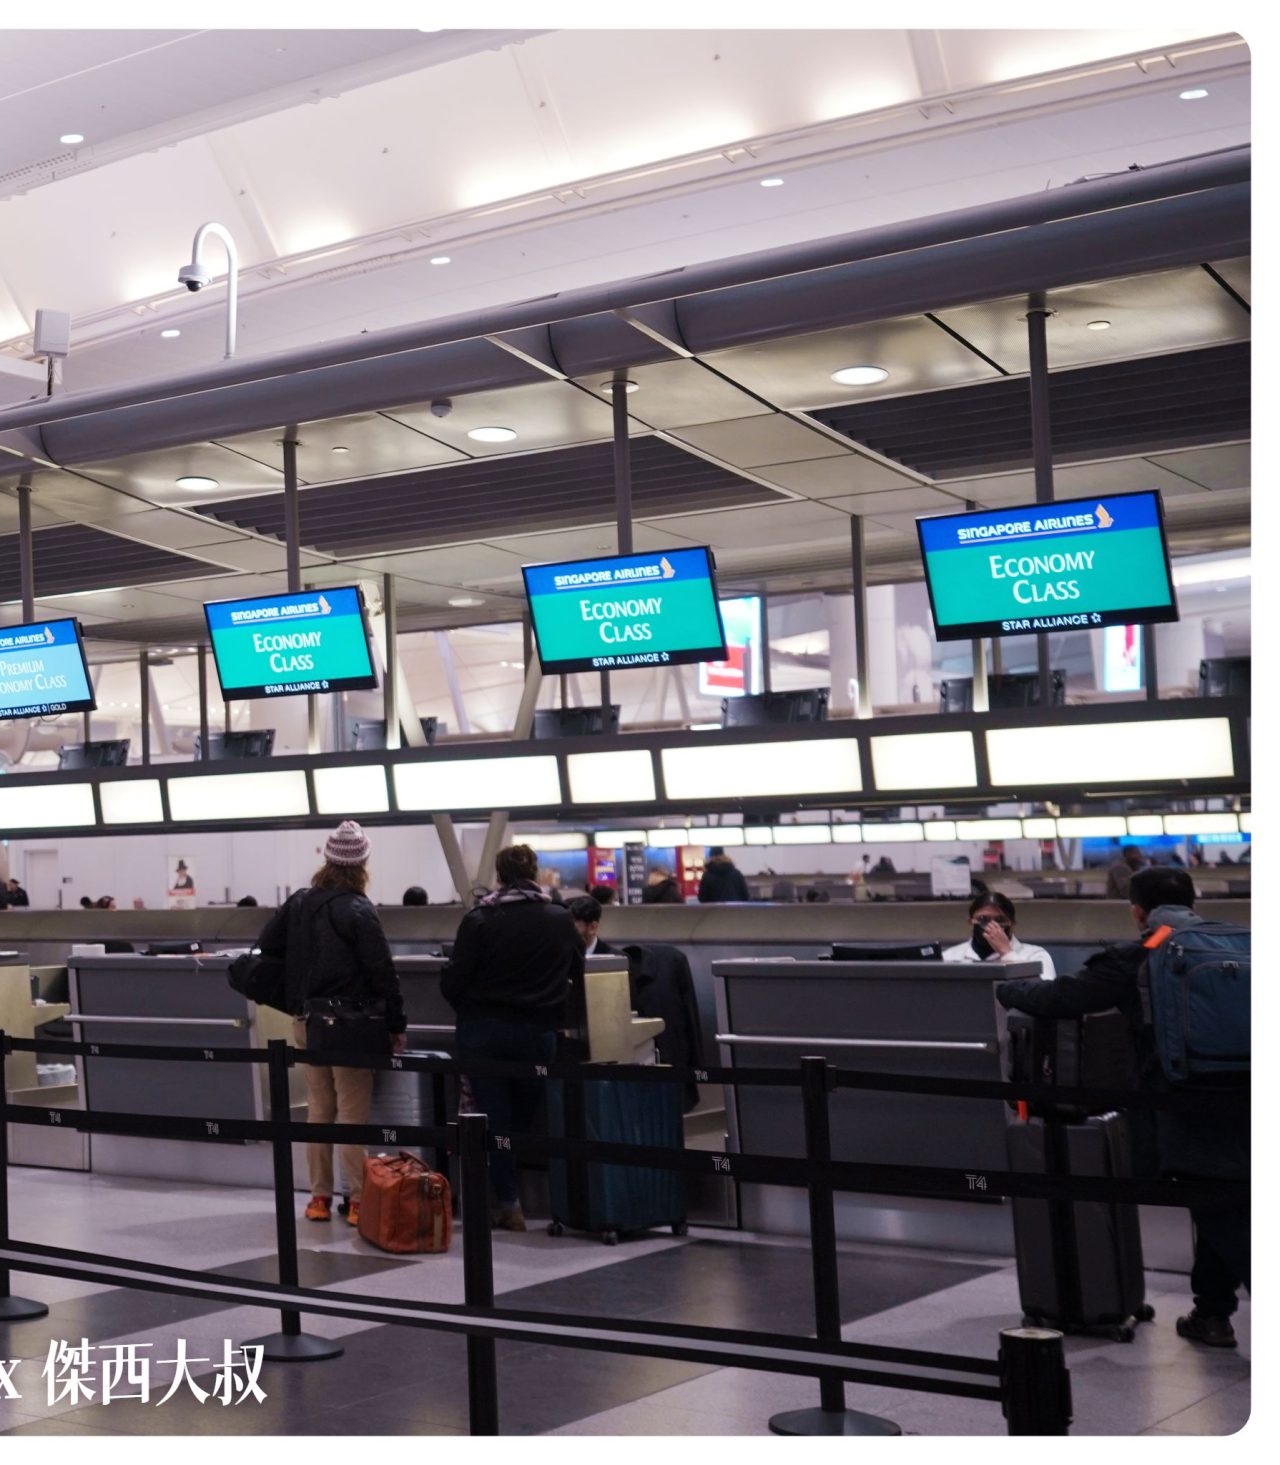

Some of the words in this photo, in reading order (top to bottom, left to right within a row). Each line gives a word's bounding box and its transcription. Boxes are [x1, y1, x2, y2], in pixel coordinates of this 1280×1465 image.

[957, 521, 1031, 540] SINGAPORE
[1034, 513, 1094, 531] AIRLINES
[988, 550, 1095, 579] ECONOMY
[554, 570, 612, 587] SINGAPORE
[614, 565, 660, 580] AIRLINES
[1012, 580, 1080, 604] CLASS
[231, 607, 279, 621] SINGAPORE
[280, 602, 319, 615] AIRLINES
[580, 598, 662, 621] ECONOMY
[1001, 619, 1031, 632] STAR
[1033, 614, 1089, 629] ALLIANCE
[14, 633, 45, 645] AIRLINES
[599, 621, 652, 643] CLASS
[253, 631, 322, 653] ECONOMY
[0, 660, 45, 677] PREMIUM
[270, 653, 314, 673] CLASS
[592, 655, 616, 667] STAR
[616, 653, 659, 665] ALLIANCE
[34, 673, 67, 690] CLASS
[264, 685, 284, 694] STAR
[285, 681, 321, 692] ALLIANCE
[50, 703, 67, 711] GOLD
[390, 1058, 402, 1069] T4
[535, 1065, 548, 1076] T4
[694, 1070, 708, 1081] T4
[49, 1111, 61, 1123] T4
[205, 1121, 219, 1135] T4
[382, 1128, 397, 1142] T4
[494, 1136, 511, 1150] T4
[711, 1156, 731, 1172] T4
[964, 1174, 988, 1191] T4
